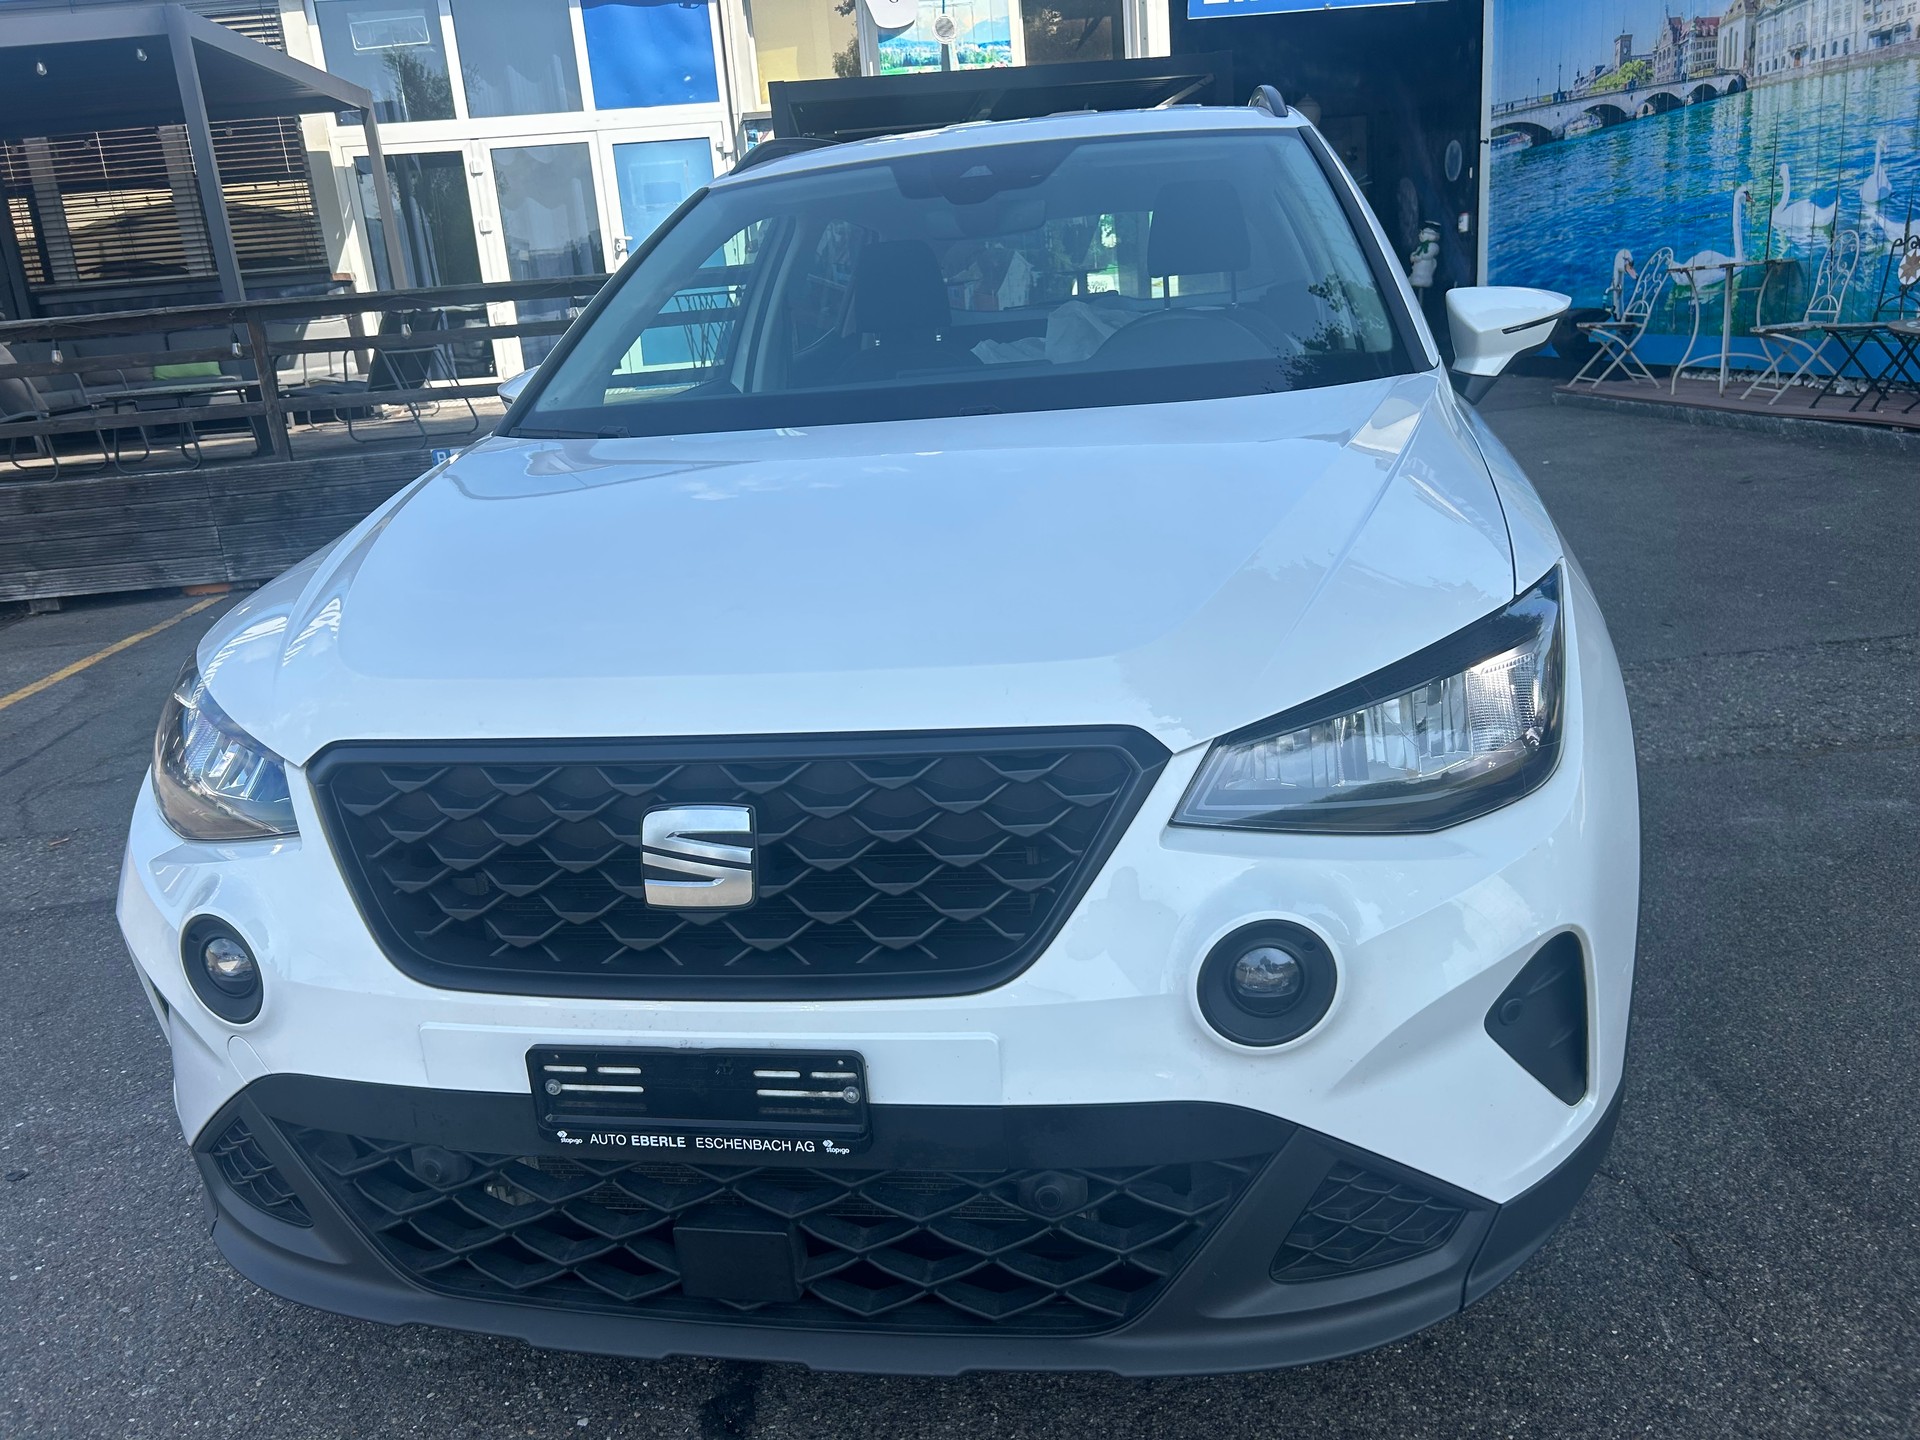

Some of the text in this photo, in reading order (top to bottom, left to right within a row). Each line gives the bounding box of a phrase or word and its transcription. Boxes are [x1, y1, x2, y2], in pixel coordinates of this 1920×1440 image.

[590, 1133, 815, 1152] AUTO EBERLE ESCHENBACH AG
